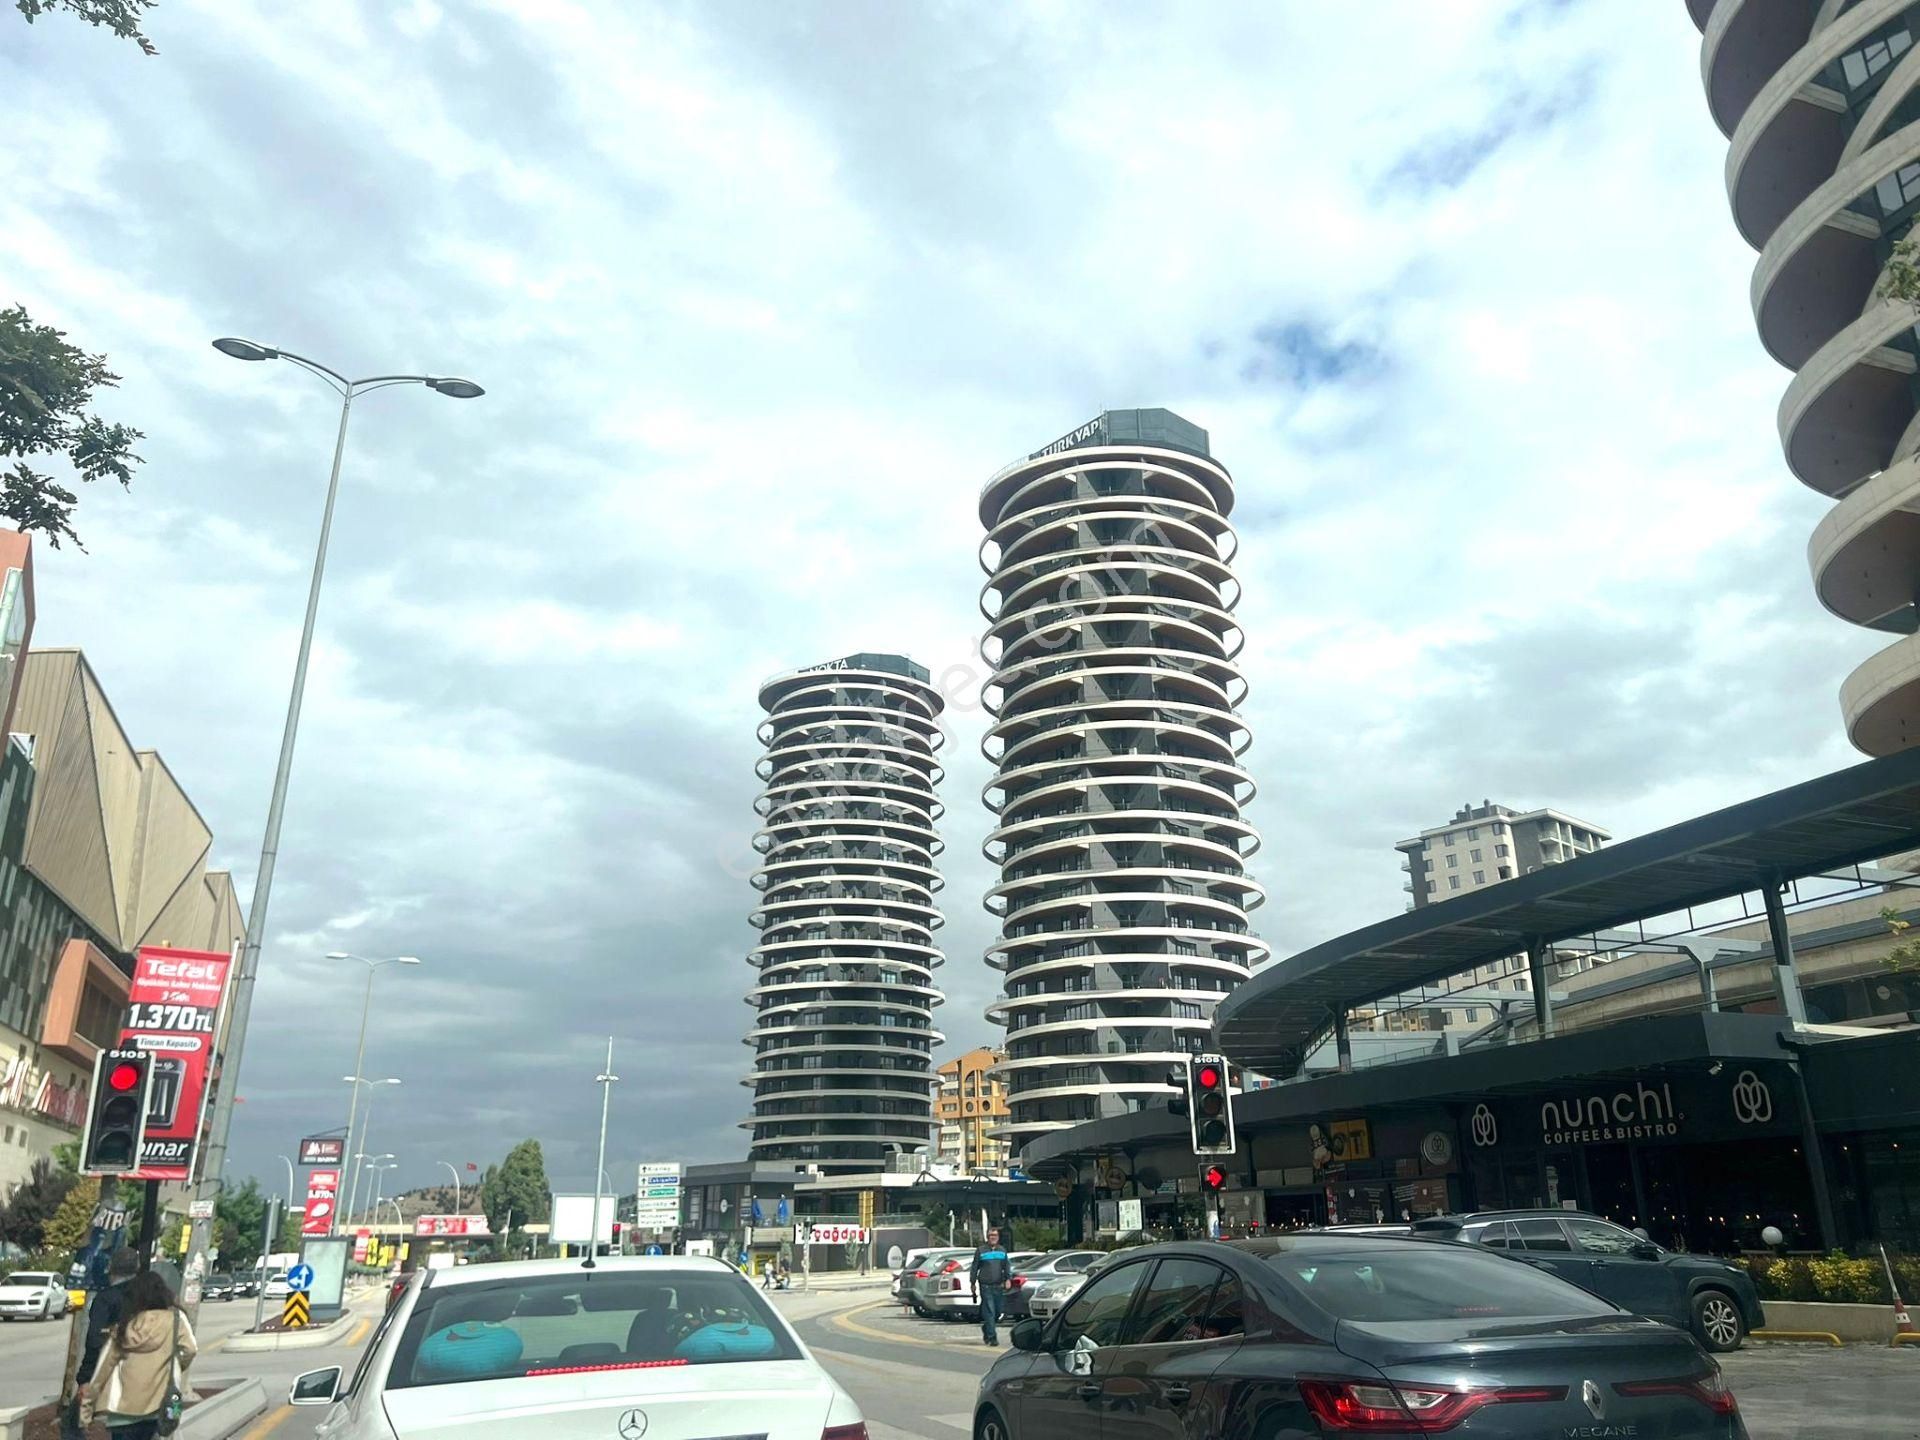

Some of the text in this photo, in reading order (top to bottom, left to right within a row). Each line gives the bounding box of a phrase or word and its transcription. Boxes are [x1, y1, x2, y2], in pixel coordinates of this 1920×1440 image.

[146, 959, 217, 979] Tefal
[109, 1050, 147, 1059] 5105
[1563, 1425, 1638, 1438] MEGANE
